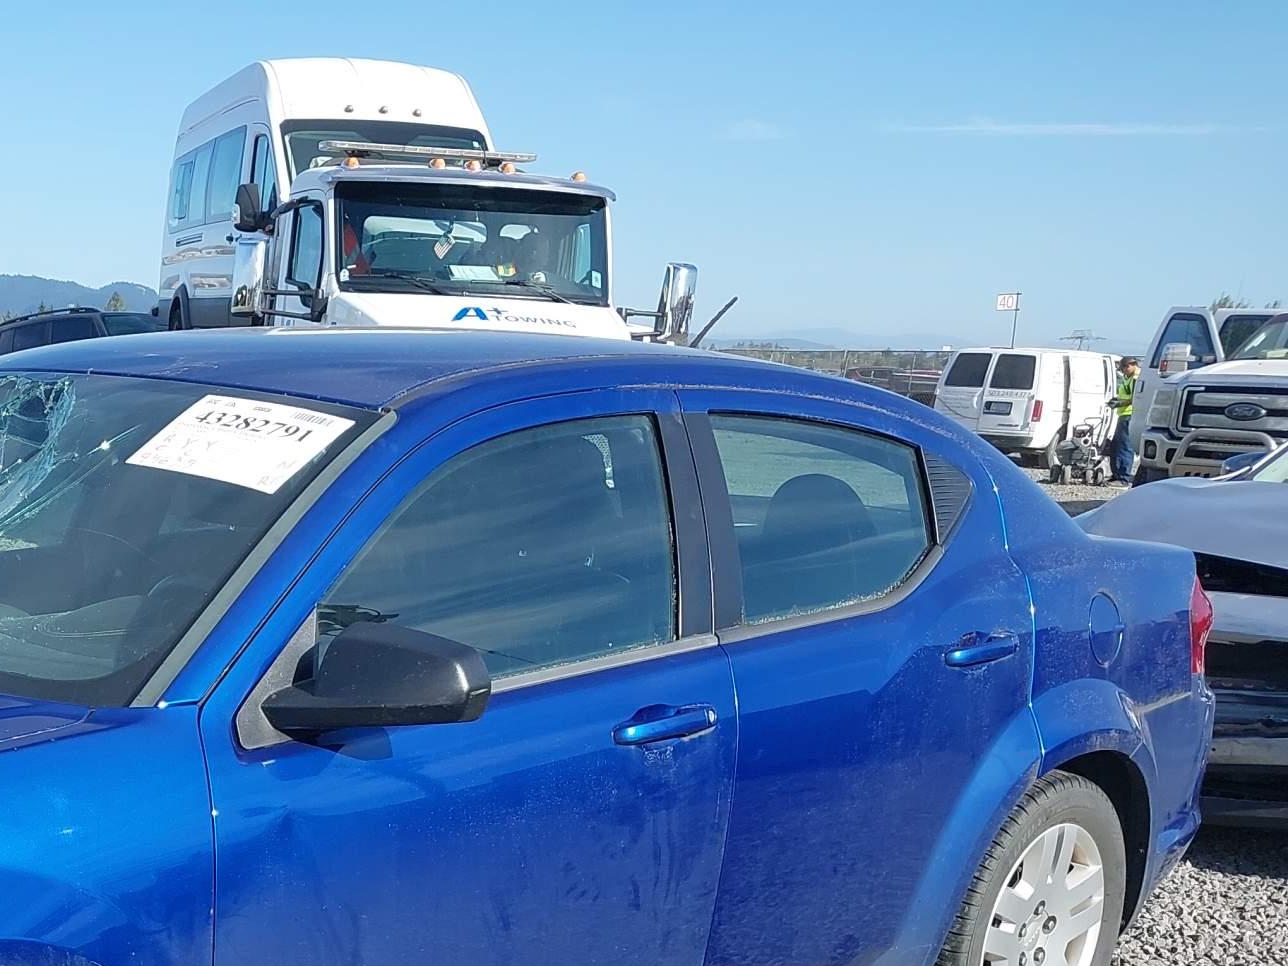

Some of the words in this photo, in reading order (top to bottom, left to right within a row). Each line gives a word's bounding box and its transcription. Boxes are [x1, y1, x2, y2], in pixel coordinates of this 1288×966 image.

[999, 296, 1014, 308] 40
[491, 314, 577, 328] TOWING
[195, 410, 313, 442] 43282791
